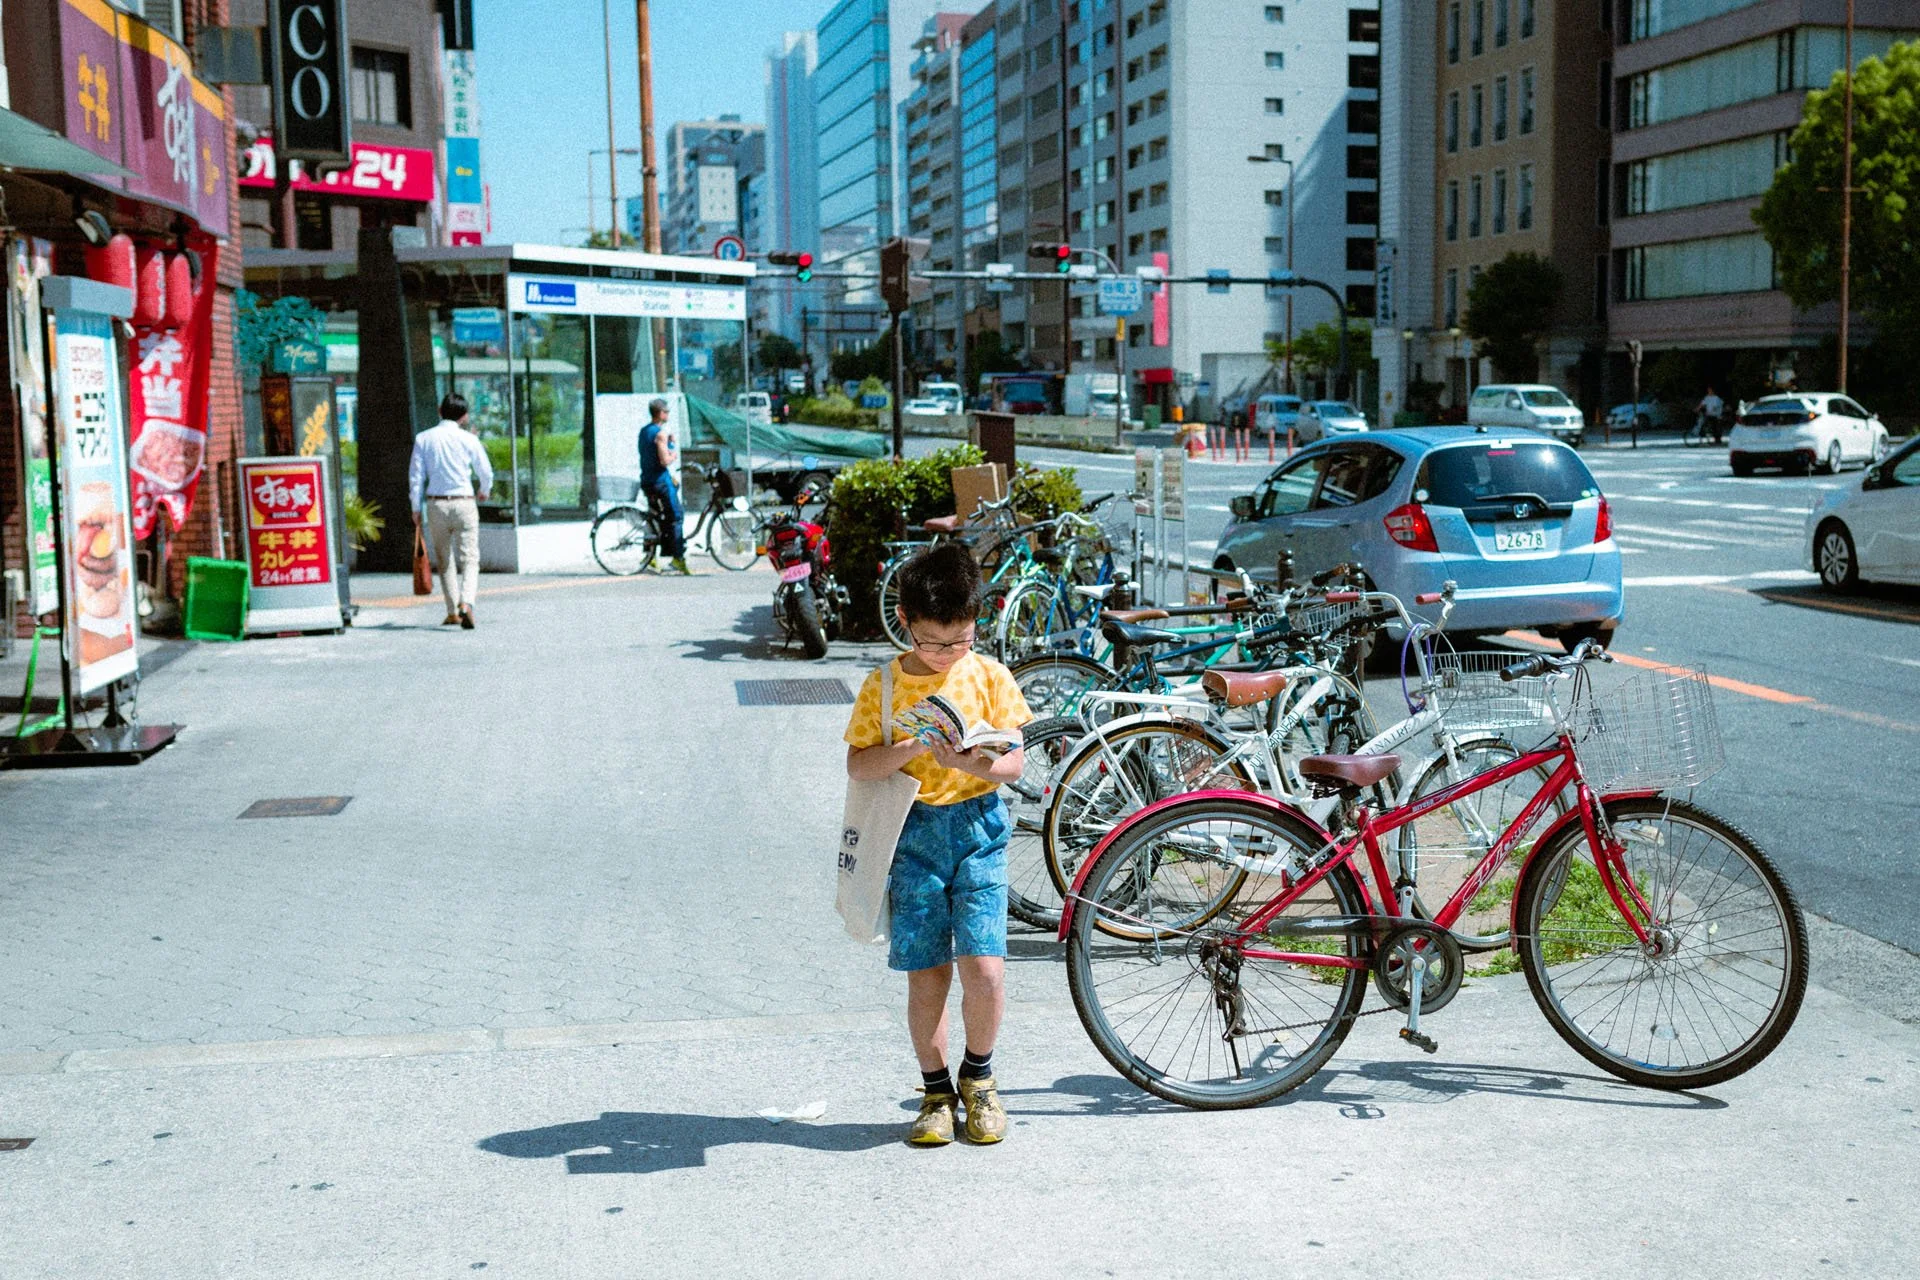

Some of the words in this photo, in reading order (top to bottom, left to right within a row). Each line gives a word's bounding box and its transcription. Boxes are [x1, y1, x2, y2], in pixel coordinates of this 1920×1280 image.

[258, 529, 318, 550] 牛丼
[259, 550, 320, 569] カレー
